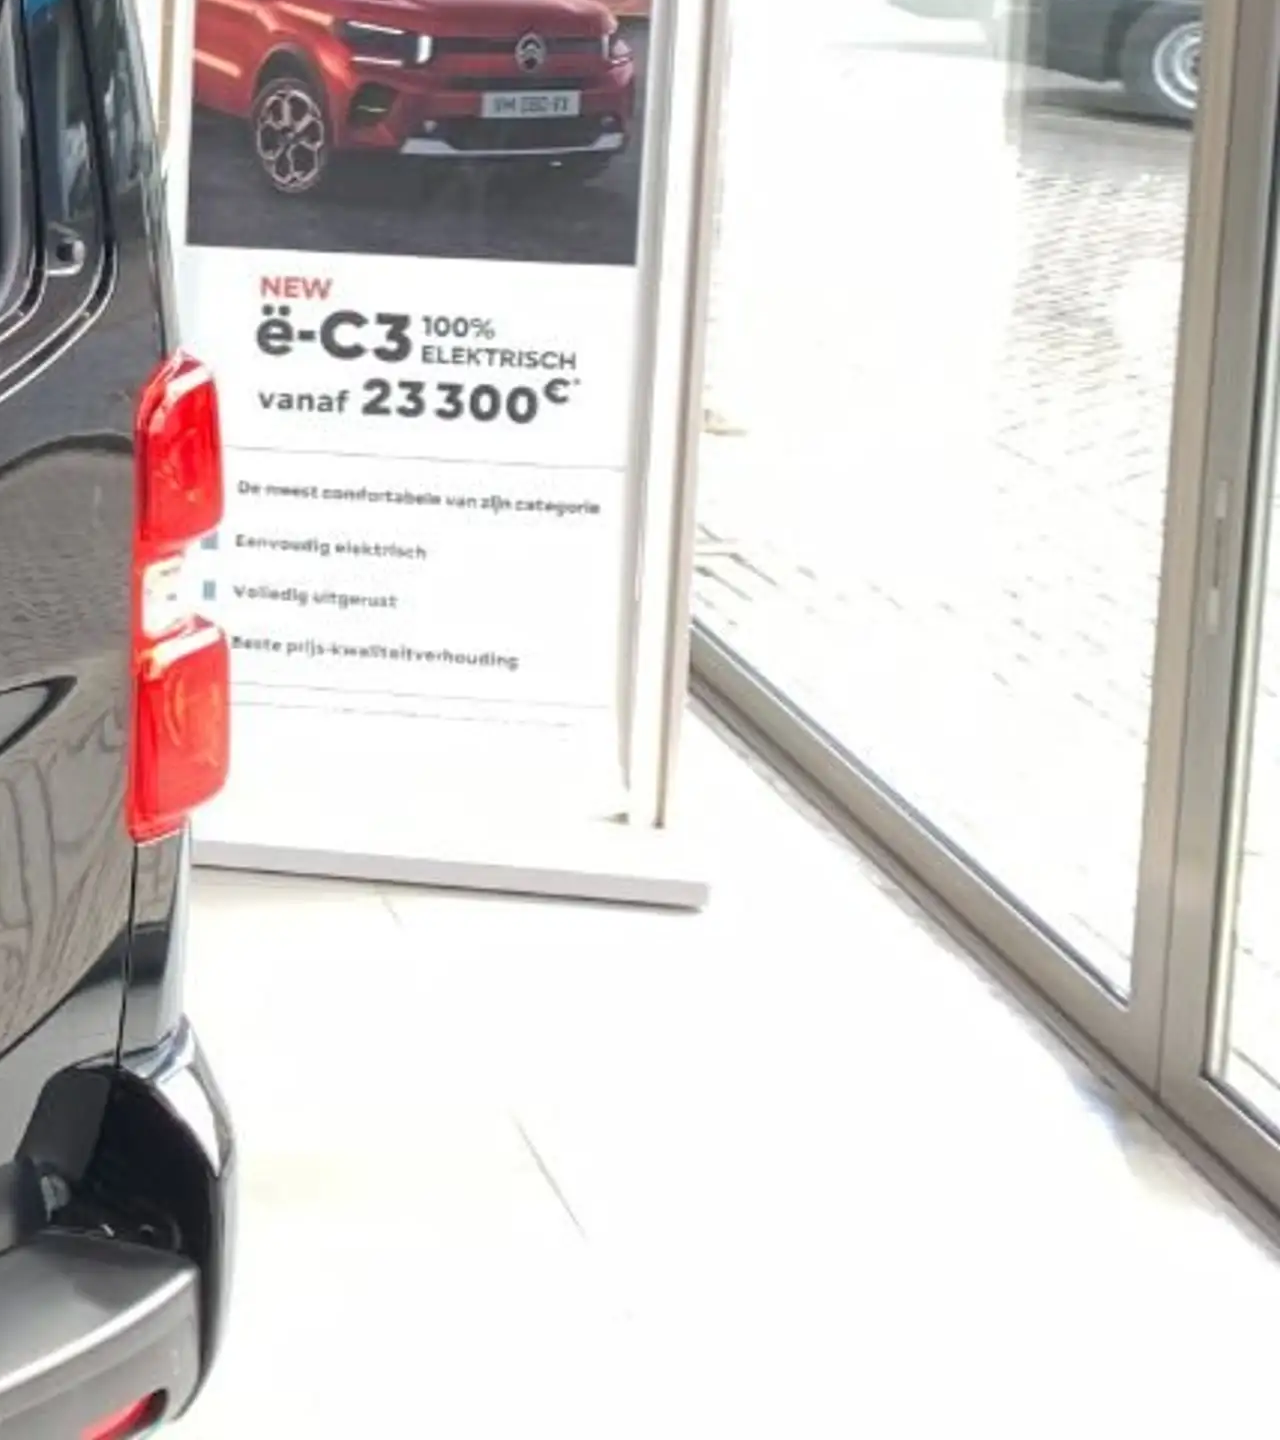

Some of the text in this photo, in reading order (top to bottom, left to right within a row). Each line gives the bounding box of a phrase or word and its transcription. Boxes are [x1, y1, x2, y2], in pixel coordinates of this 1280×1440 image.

[260, 276, 333, 300] NEW
[421, 315, 496, 340] 100%
[421, 345, 577, 371] ELEKTRISCH
[258, 389, 350, 414] vanaf
[237, 479, 601, 518] De meest comfortabele van zijn categorie
[235, 533, 427, 561] Eenvoudig elektrisch
[233, 584, 398, 610] Volledig uitgerust
[231, 635, 282, 652] Beste
